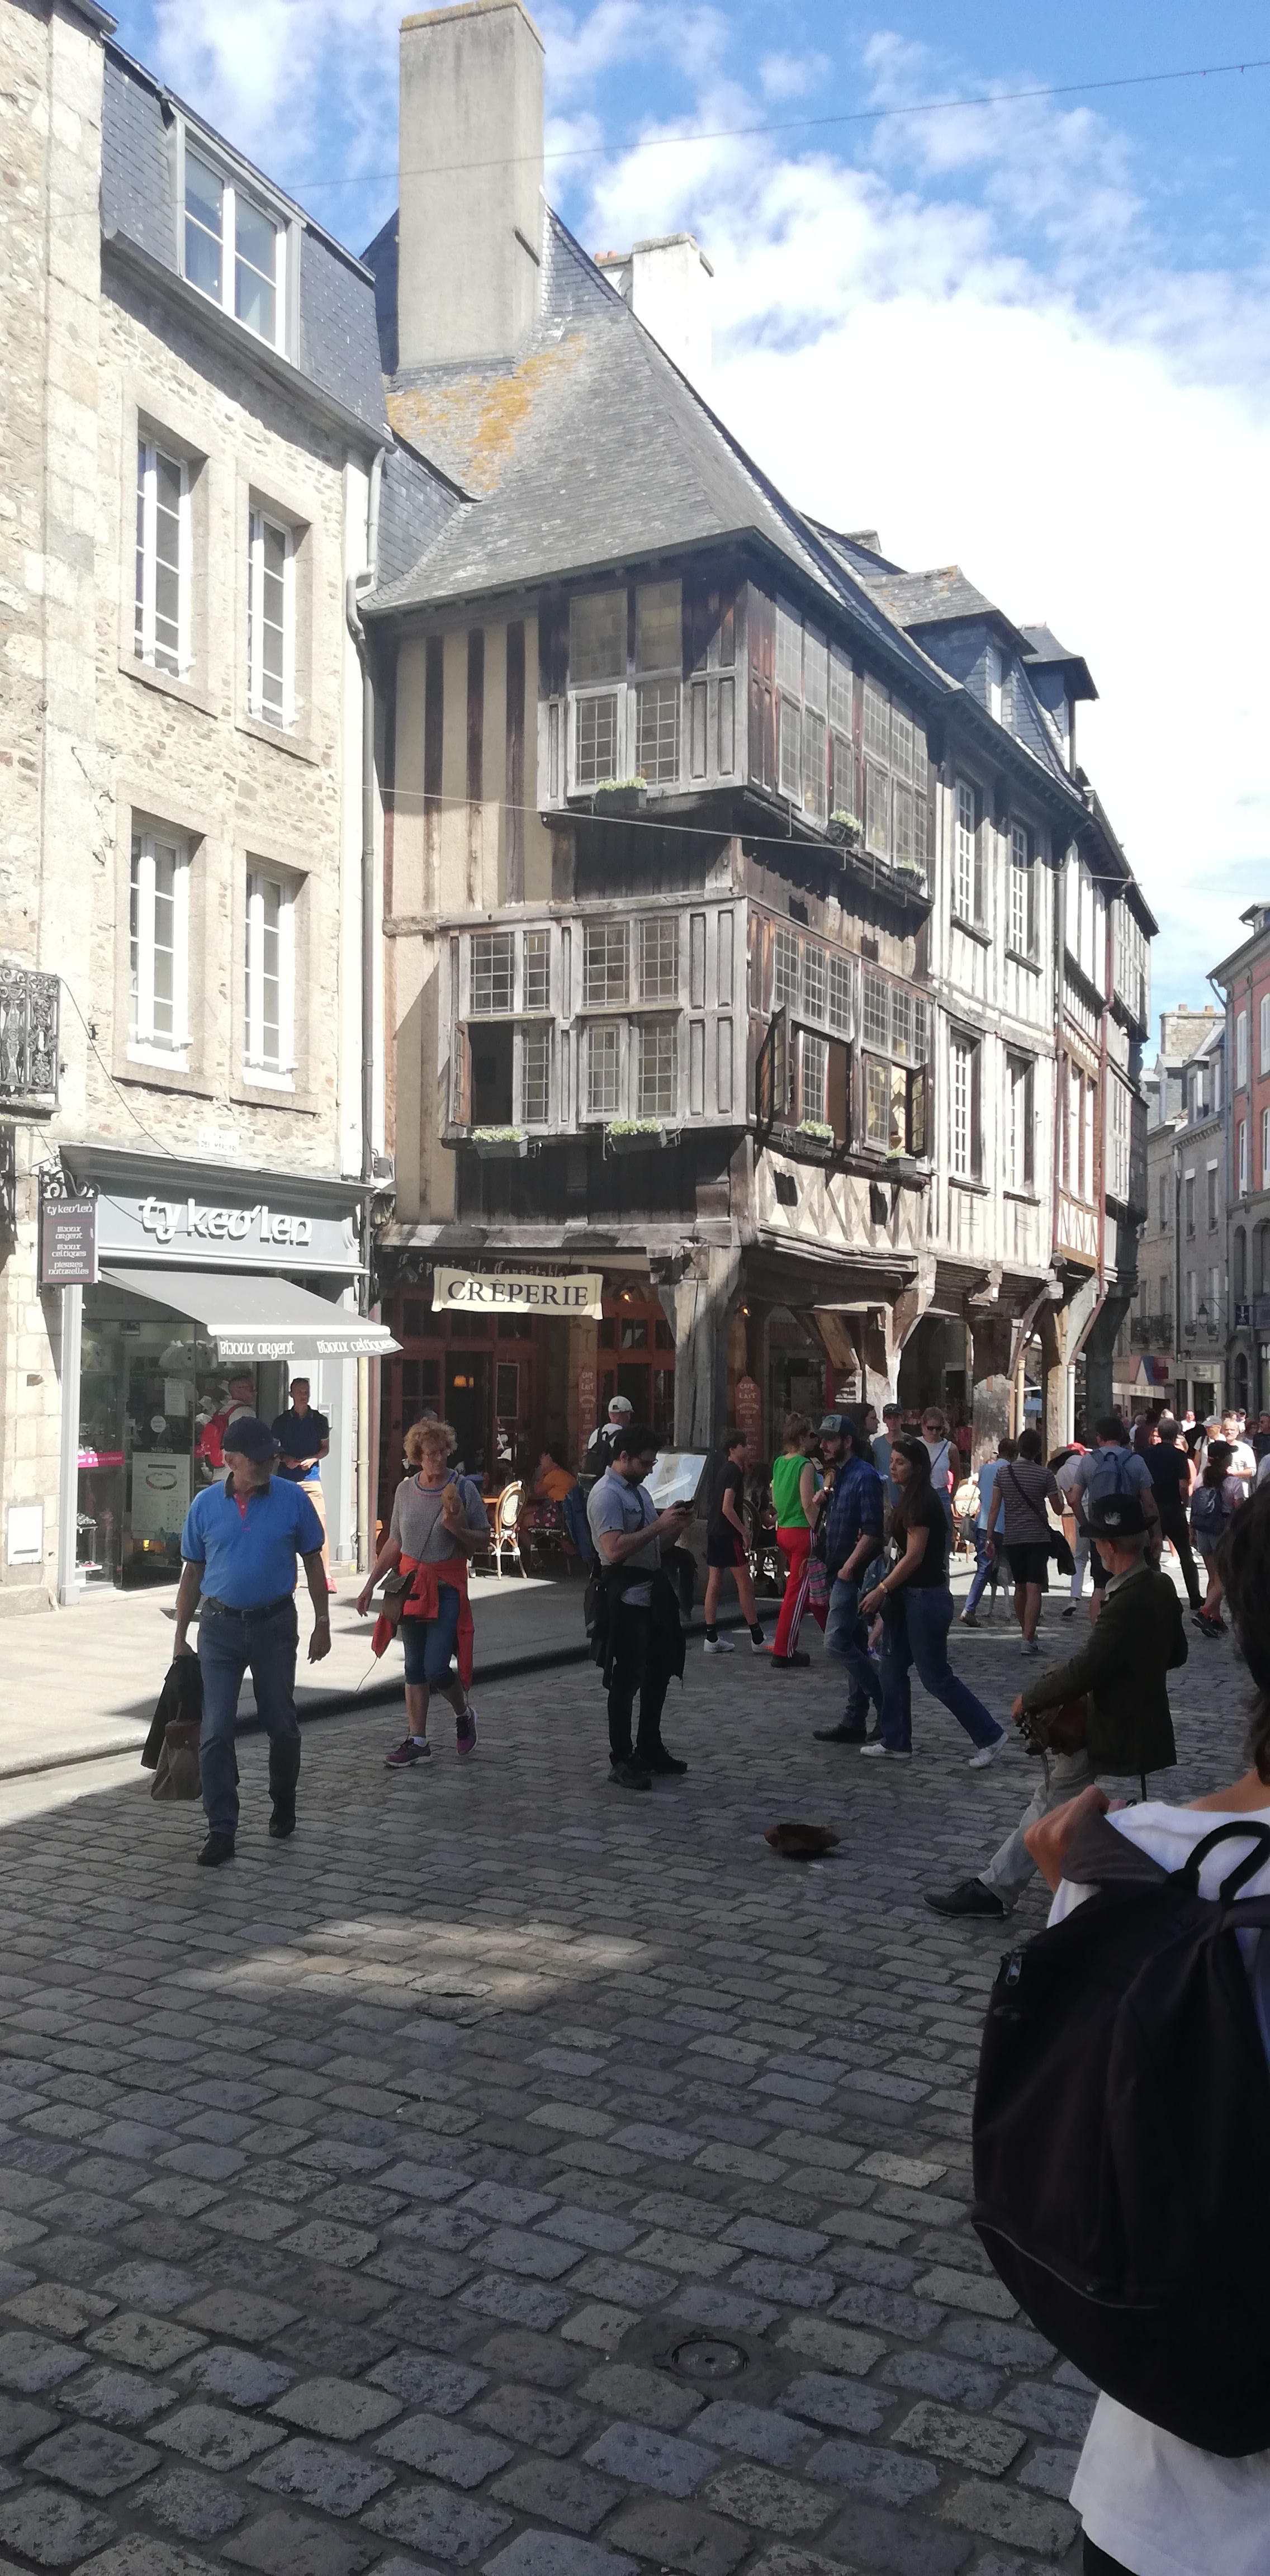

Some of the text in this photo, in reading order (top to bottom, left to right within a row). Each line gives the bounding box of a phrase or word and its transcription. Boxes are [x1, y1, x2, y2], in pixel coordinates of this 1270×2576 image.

[46, 1205, 57, 1216] ty
[139, 1196, 183, 1241] ty
[55, 1232, 83, 1241] argent
[51, 1249, 87, 1258] celtiques
[54, 1261, 83, 1270] pierres
[447, 1278, 589, 1306] CRÊPERIE
[219, 1340, 296, 1359] Bijoux argent
[316, 1338, 396, 1354] Bijoux celtiques
